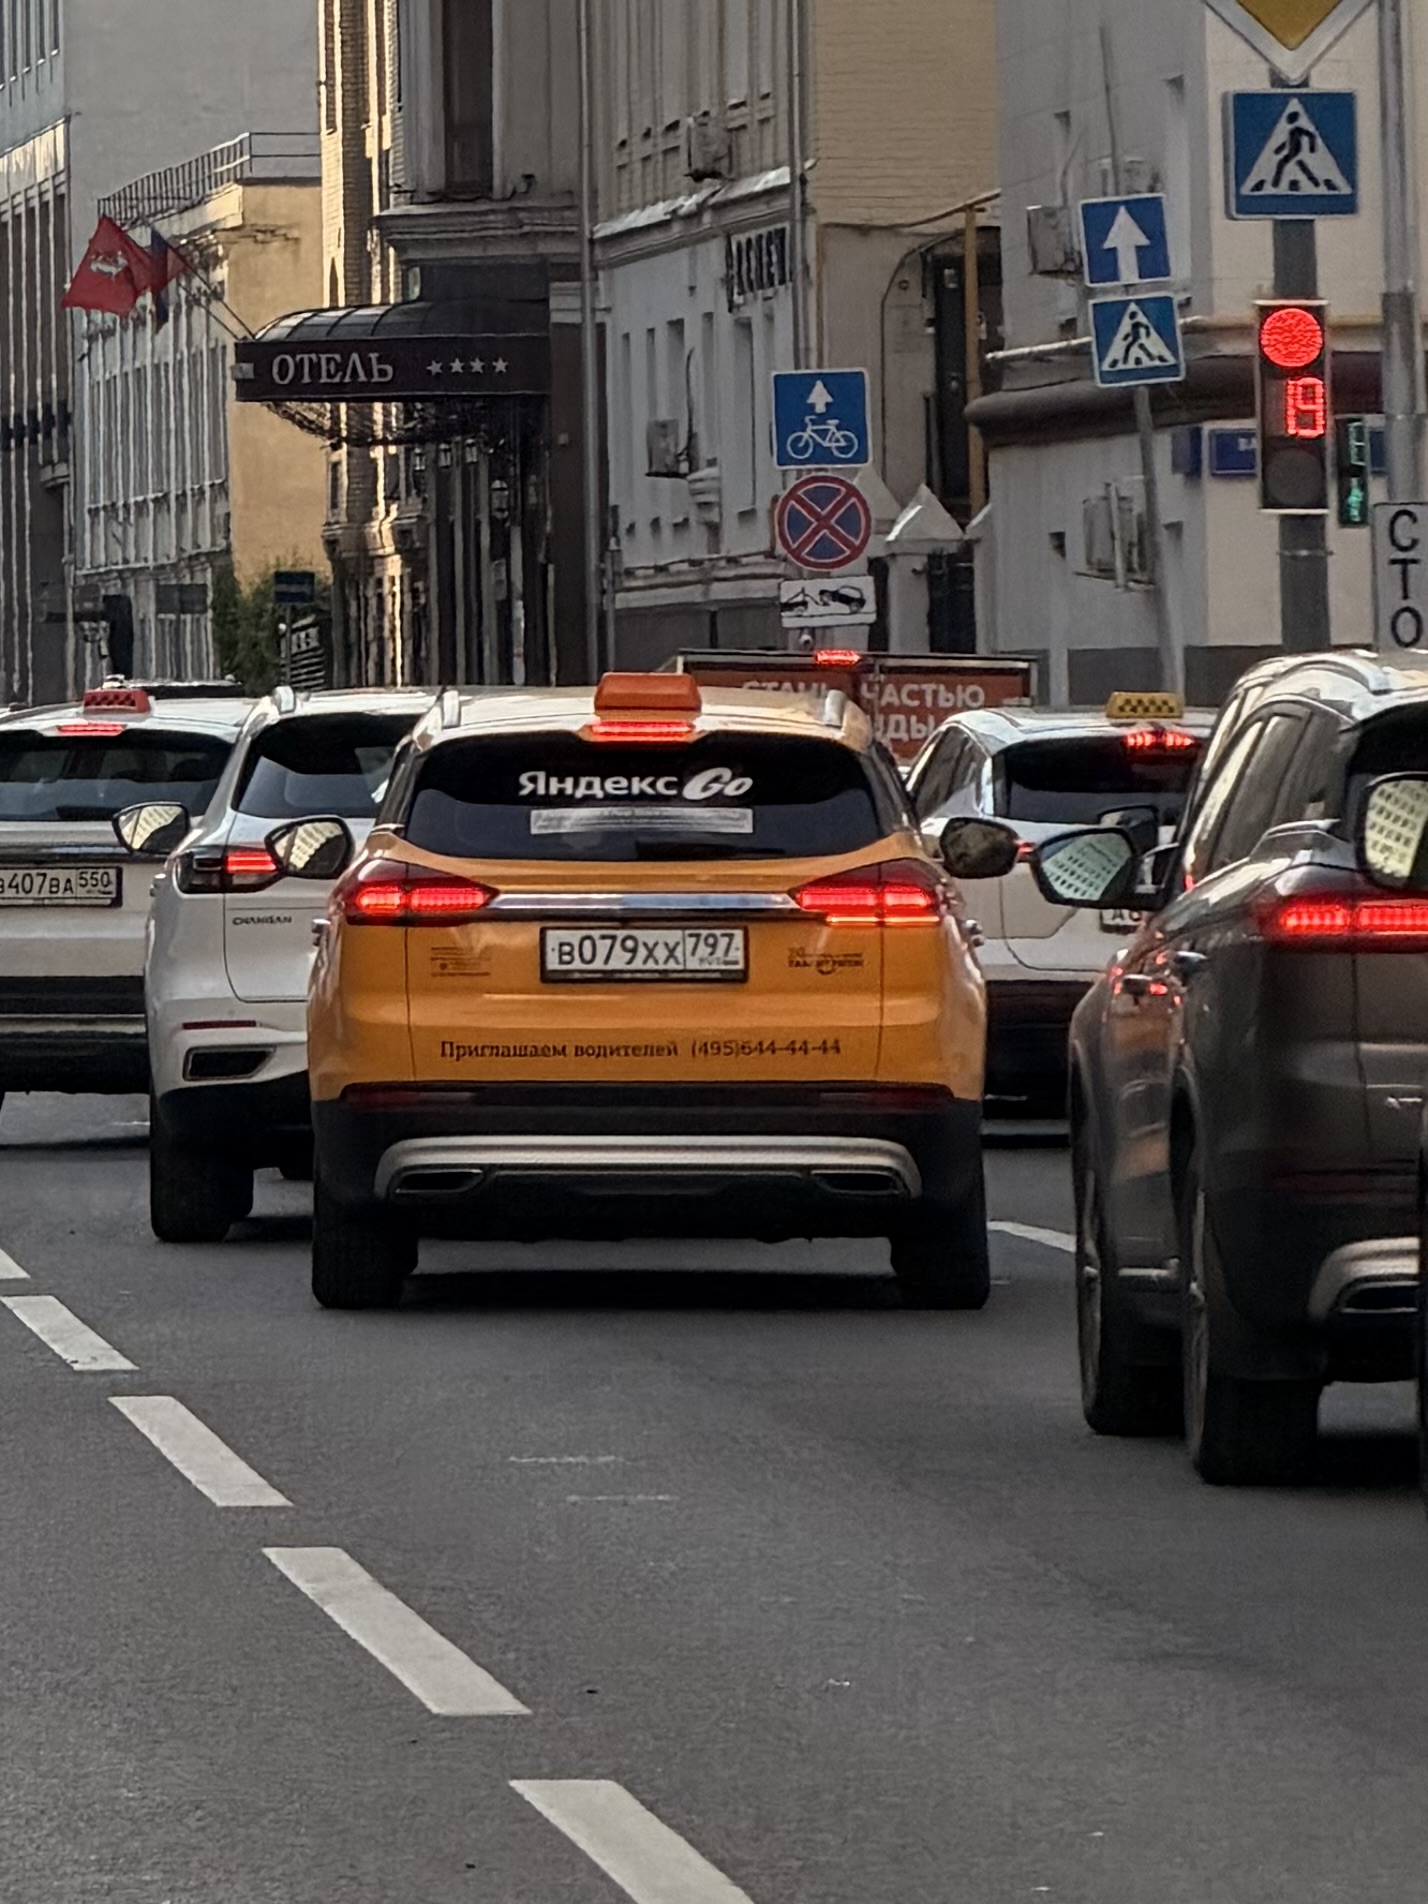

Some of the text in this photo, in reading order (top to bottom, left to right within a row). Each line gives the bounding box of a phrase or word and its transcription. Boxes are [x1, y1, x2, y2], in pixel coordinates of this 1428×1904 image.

[272, 352, 394, 385] ОТЕЛЬ
[860, 682, 986, 708] ЧАСТЬЮ
[519, 767, 753, 800] Яндекс Go
[78, 871, 111, 888] 550
[557, 933, 735, 966] В079ХХ 797
